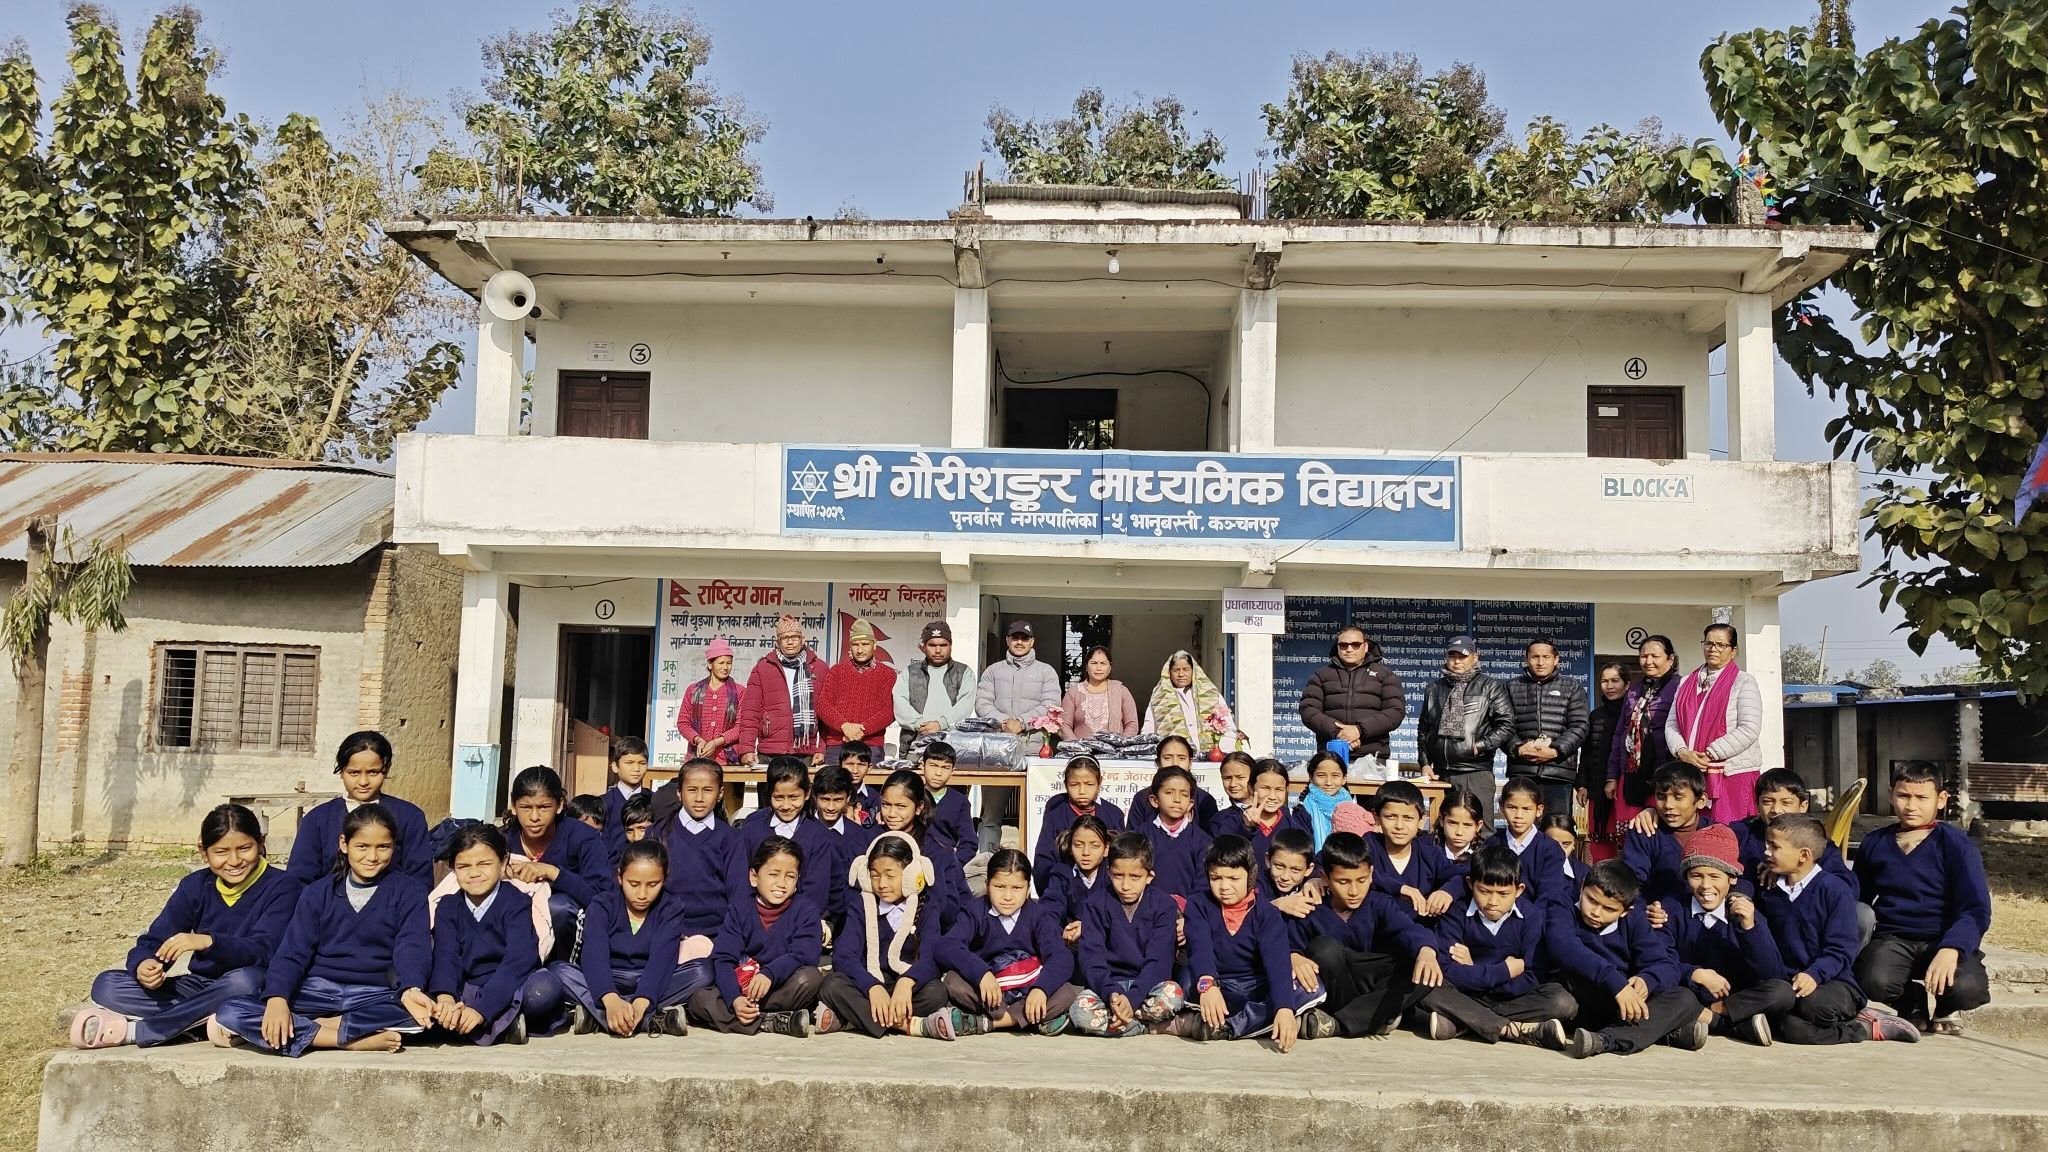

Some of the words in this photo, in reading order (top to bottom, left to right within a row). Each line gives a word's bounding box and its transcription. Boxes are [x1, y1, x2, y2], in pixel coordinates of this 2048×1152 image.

[832, 453, 882, 499] श्री
[1089, 460, 1284, 506] माध्यमिक
[1296, 460, 1454, 511] विद्यालय
[1010, 508, 1098, 531] नगरपालिका
[697, 579, 748, 609] राष्ट्रिय
[750, 586, 784, 606] गान
[848, 583, 891, 608] राष्ट्रिय
[889, 609, 914, 620] Symbols
[916, 609, 924, 618] of
[1225, 600, 1283, 612] प्रधानाध्यापक
[801, 612, 826, 632] नेपाली
[1244, 616, 1264, 627] कक्ष
